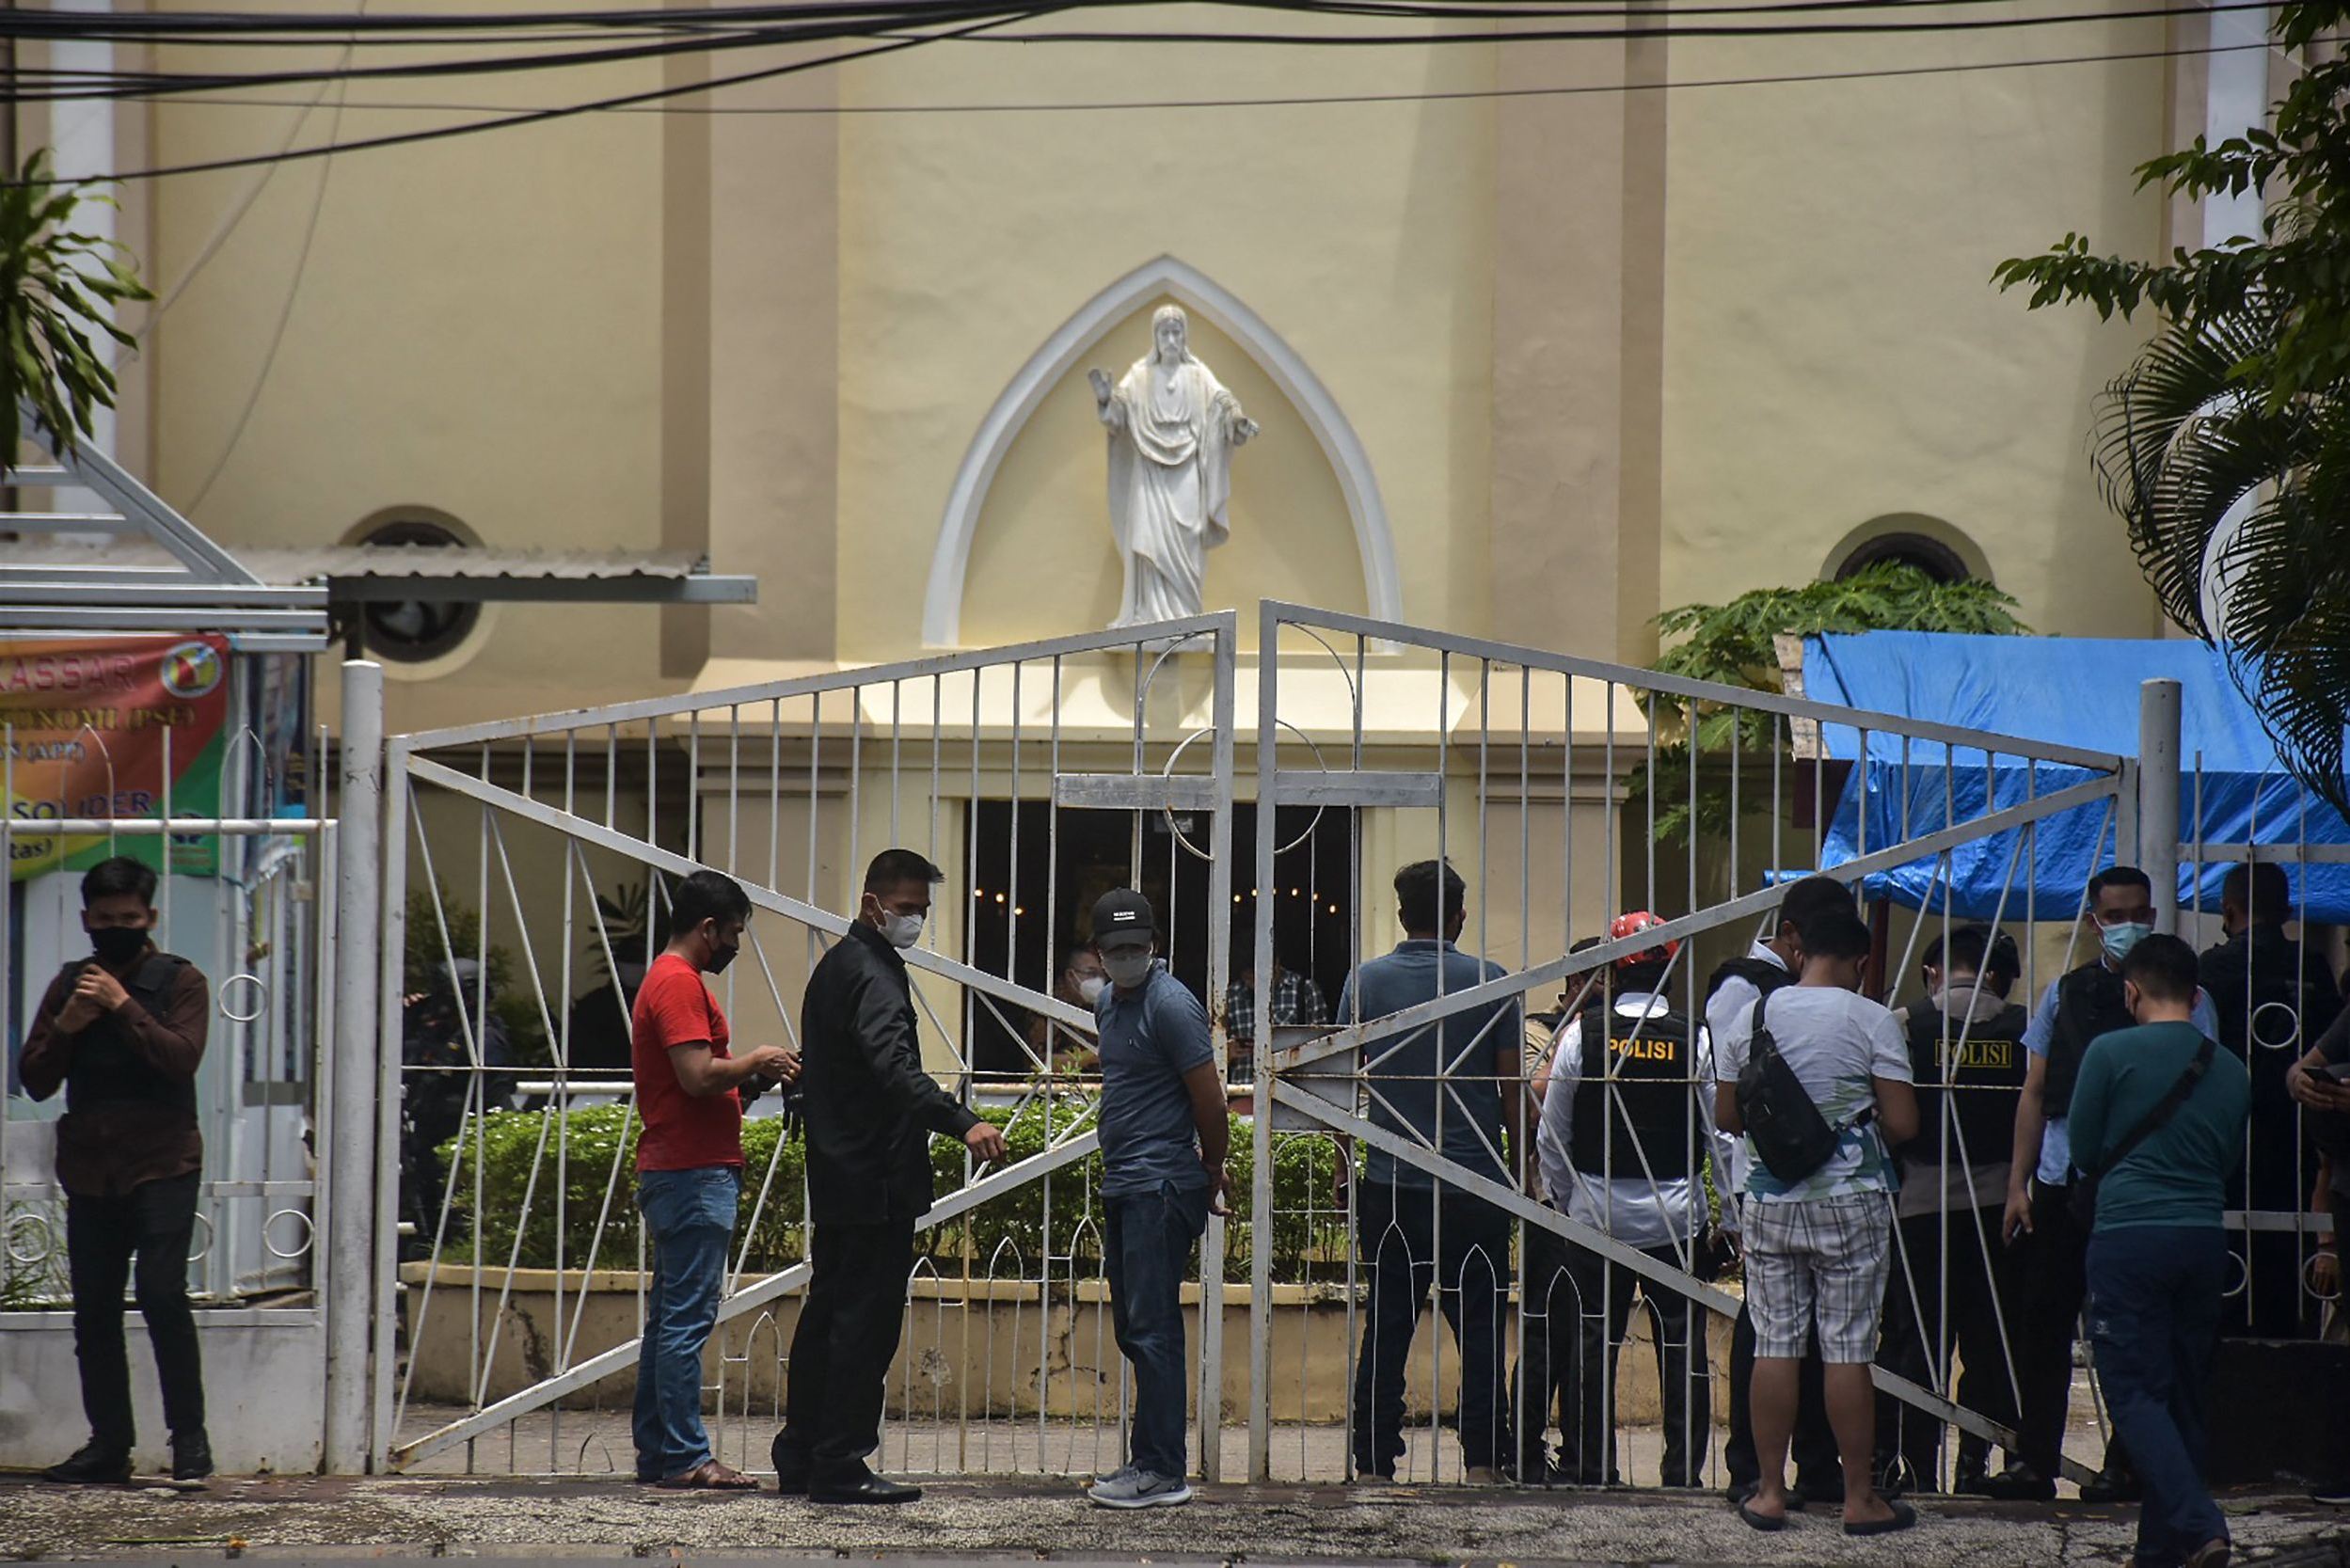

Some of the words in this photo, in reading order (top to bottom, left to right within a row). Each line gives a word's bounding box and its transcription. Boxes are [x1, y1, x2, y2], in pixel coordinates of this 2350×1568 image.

[0, 657, 135, 691] ASSAR
[0, 707, 117, 730] ONOMI
[1610, 1038, 1675, 1060] POLISI
